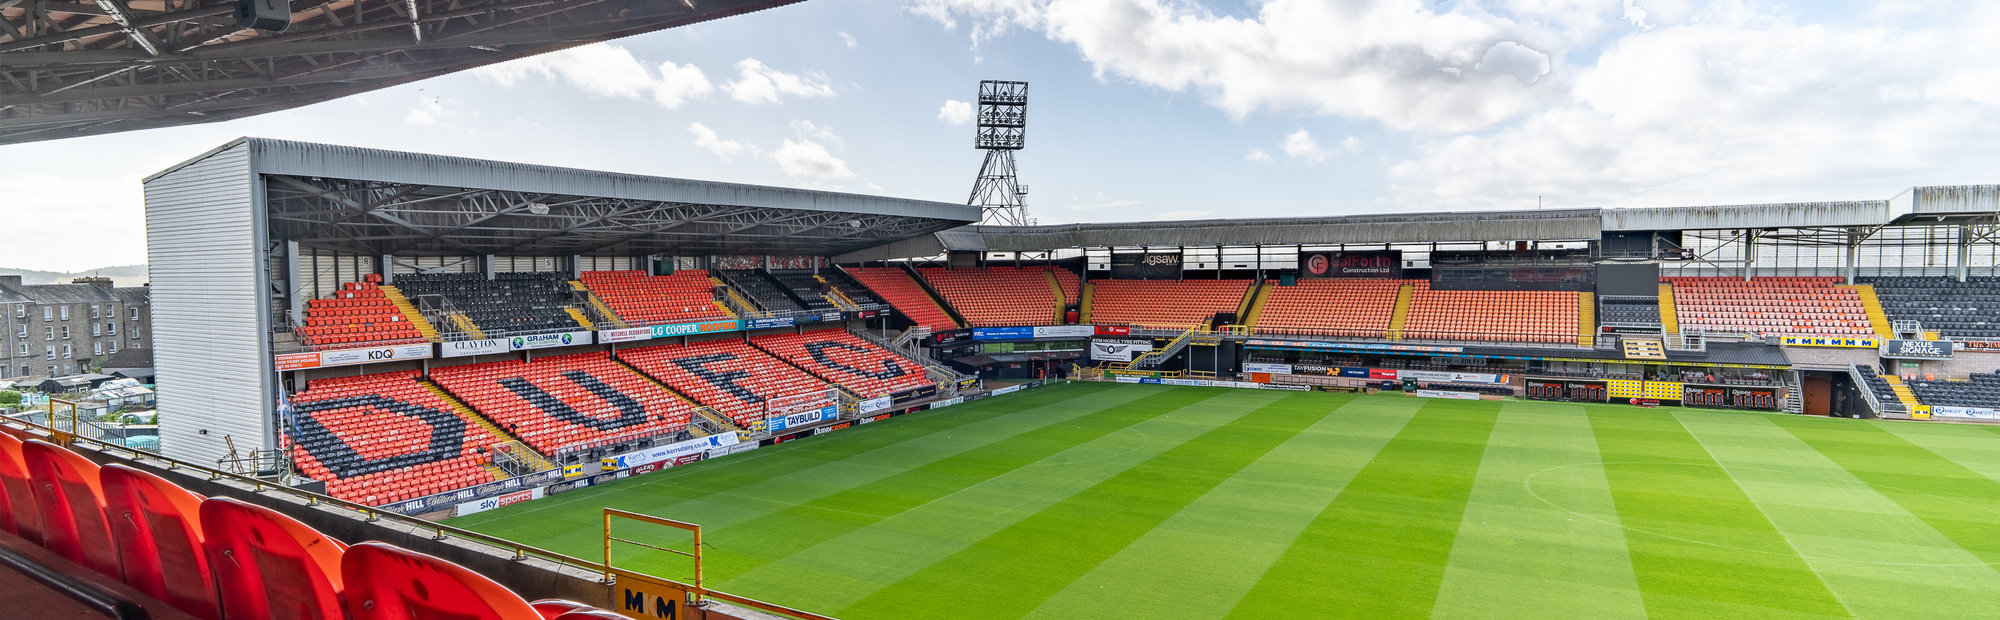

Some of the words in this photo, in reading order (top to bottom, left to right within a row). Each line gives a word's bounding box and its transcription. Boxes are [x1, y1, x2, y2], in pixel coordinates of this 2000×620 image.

[651, 326, 663, 336] LG
[666, 324, 698, 335] COOPER
[700, 321, 737, 332] ROOFING
[455, 339, 497, 350] CLAYTON
[526, 334, 559, 342] GRAHAM
[1902, 341, 1933, 349] NEXUS
[368, 348, 393, 361] KDQ
[1900, 347, 1941, 355] SIGNAGE
[787, 411, 820, 426] TAYBUILD
[627, 452, 647, 461] Kerr's
[651, 441, 709, 459] www.kerrsdairy.co.uk
[565, 467, 582, 475] MKM
[574, 478, 589, 488] HILL
[616, 469, 630, 479] HILL
[405, 499, 425, 511] HILL
[457, 488, 475, 500] HILL
[505, 478, 521, 489] HILL
[548, 469, 563, 480] HILL
[480, 499, 498, 510] sky
[500, 491, 531, 506] sports
[625, 588, 676, 620] MKM
